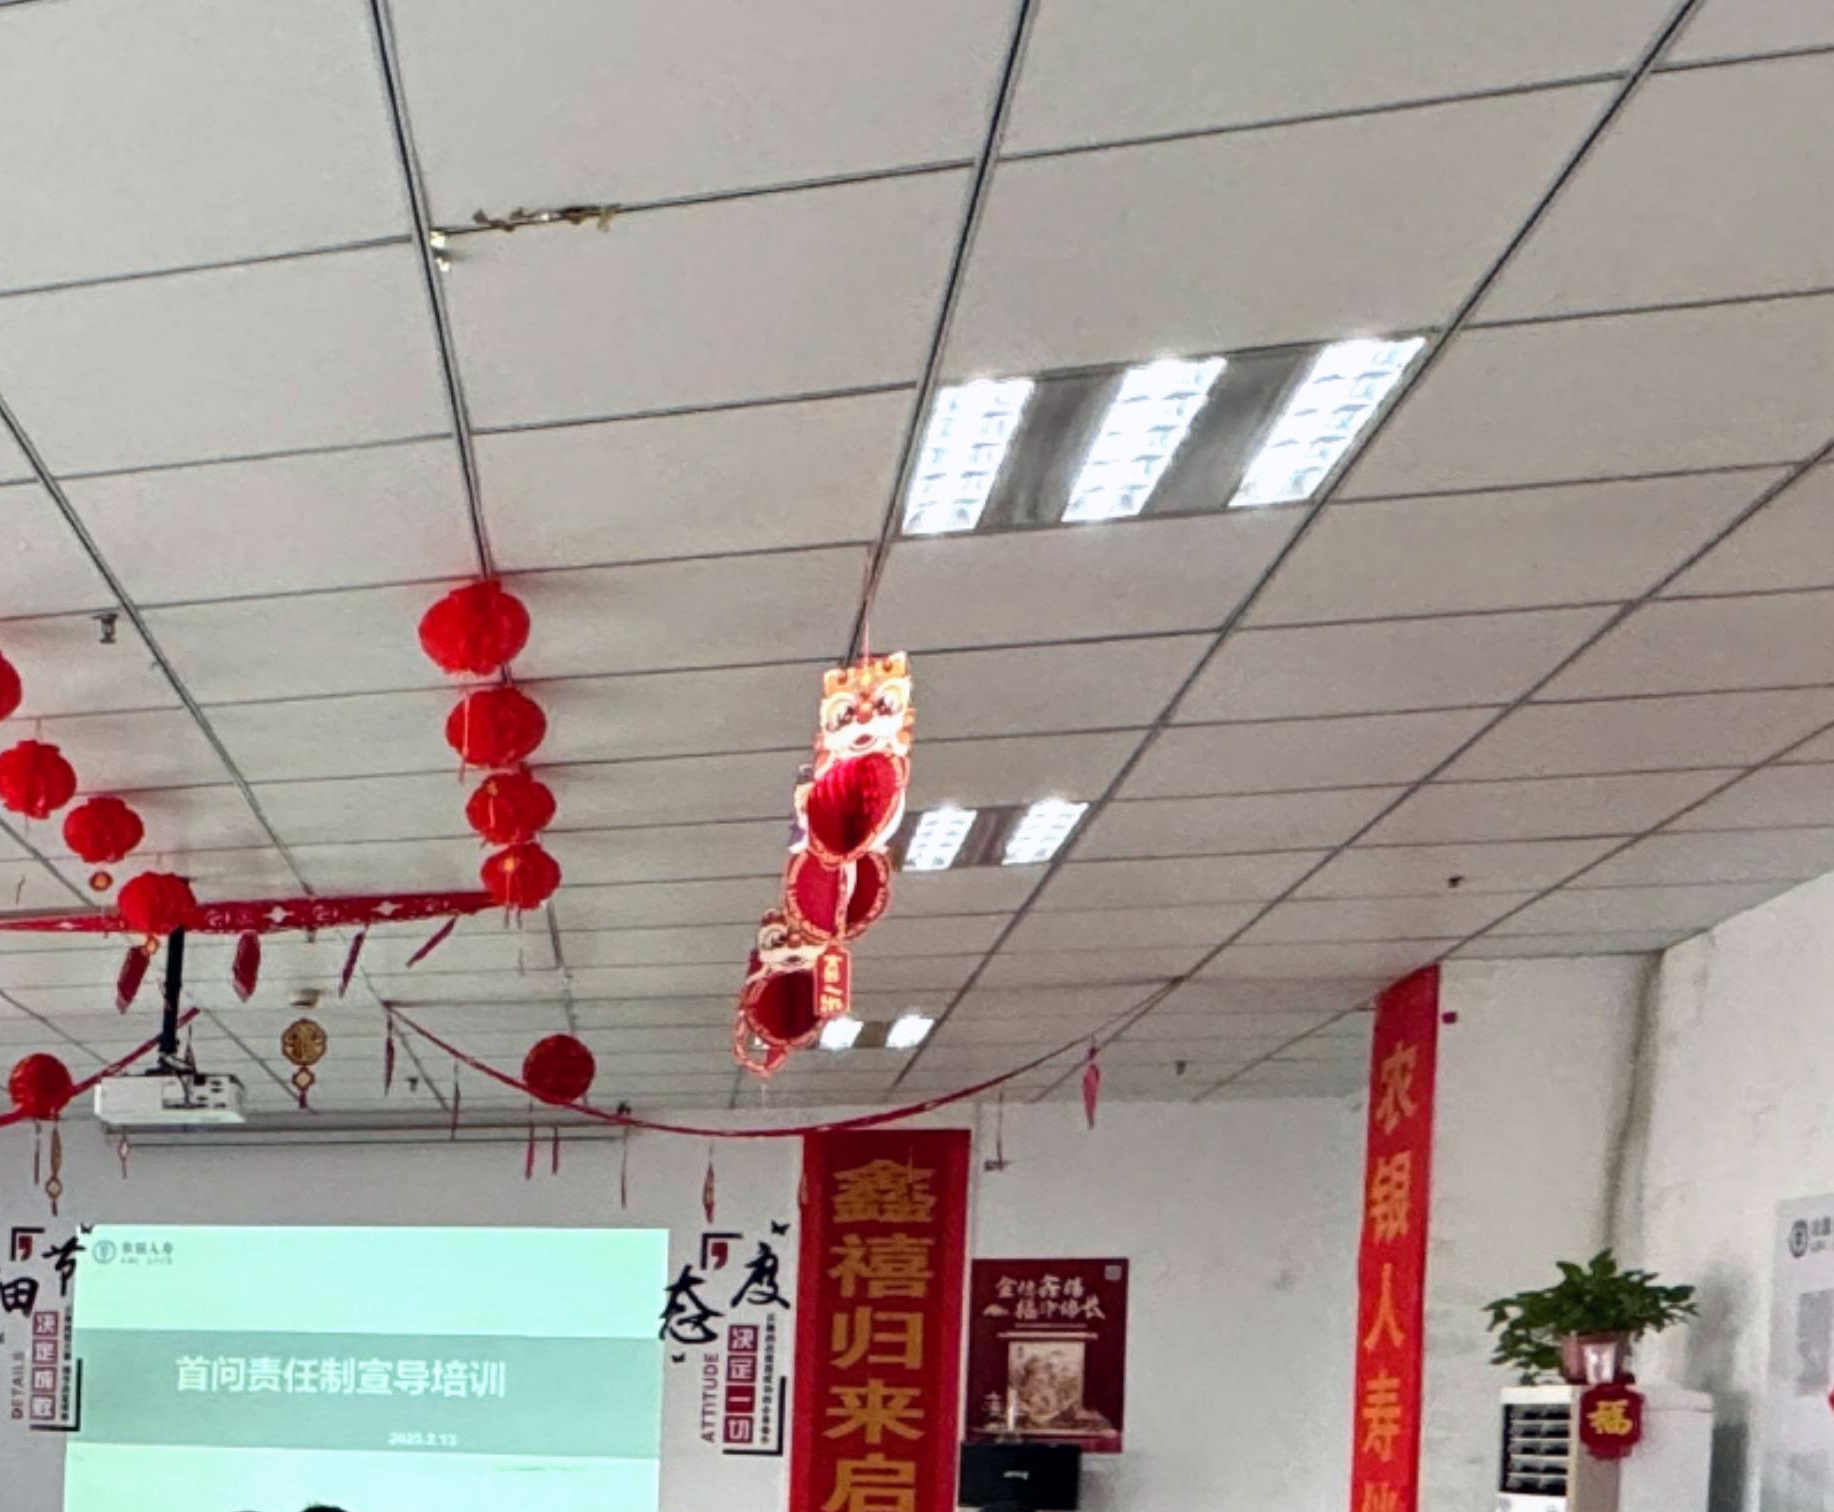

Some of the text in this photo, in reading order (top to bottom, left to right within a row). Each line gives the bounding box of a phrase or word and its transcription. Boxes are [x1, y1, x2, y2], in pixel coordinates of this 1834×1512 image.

[658, 1241, 790, 1344] 态度
[176, 1355, 506, 1399] 首问责任制宣导培训
[700, 1352, 719, 1444] ATTITUDE
[725, 1325, 759, 1443] 决定一切
